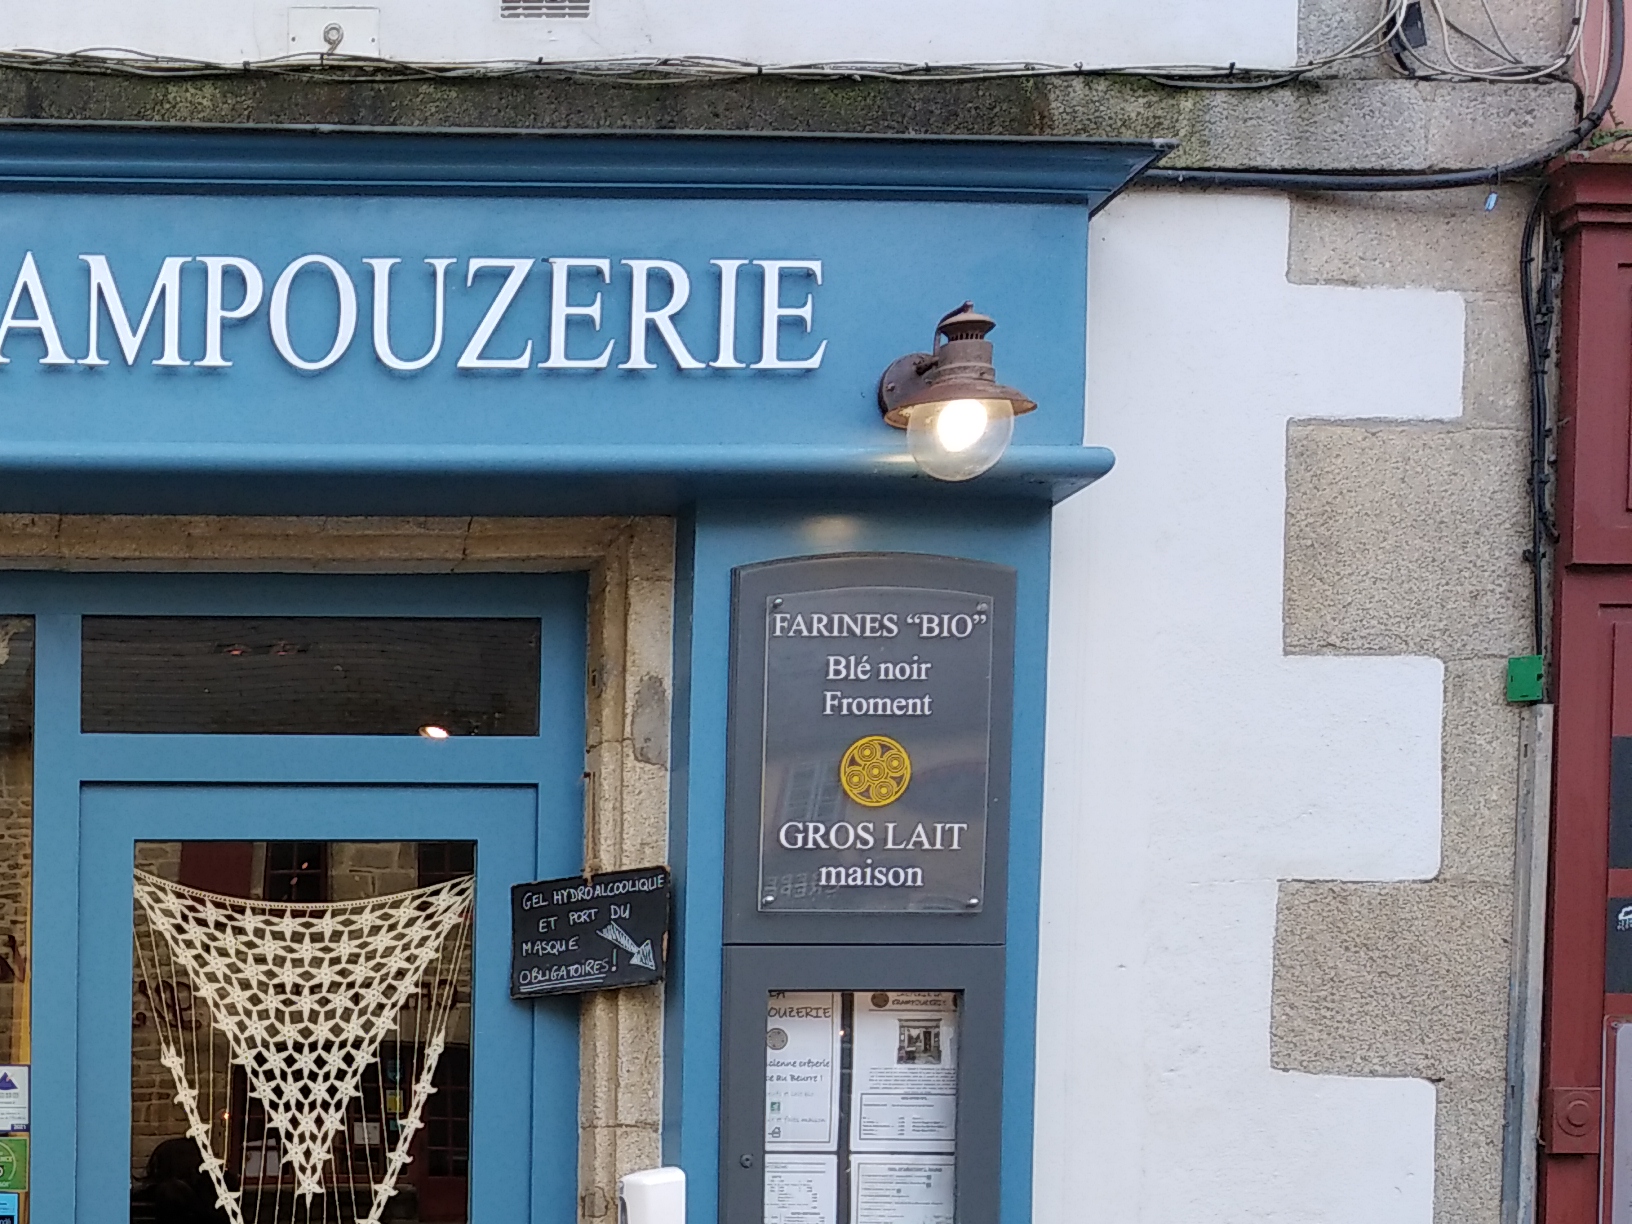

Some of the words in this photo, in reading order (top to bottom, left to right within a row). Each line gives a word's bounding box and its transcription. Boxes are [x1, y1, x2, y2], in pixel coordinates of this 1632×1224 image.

[323, 22, 345, 54] 9
[773, 613, 899, 638] FARINES
[826, 655, 871, 680] Blé
[878, 655, 932, 680] noir
[823, 691, 932, 716] Froment
[779, 821, 875, 850] GROS
[884, 822, 968, 851] LAIT
[819, 858, 924, 887] maison
[522, 893, 548, 910] GEL
[538, 916, 558, 933] ET
[569, 908, 598, 926] PORT
[610, 903, 631, 919] DU
[522, 936, 580, 957] MASQUE
[789, 1073, 818, 1083] Beurre
